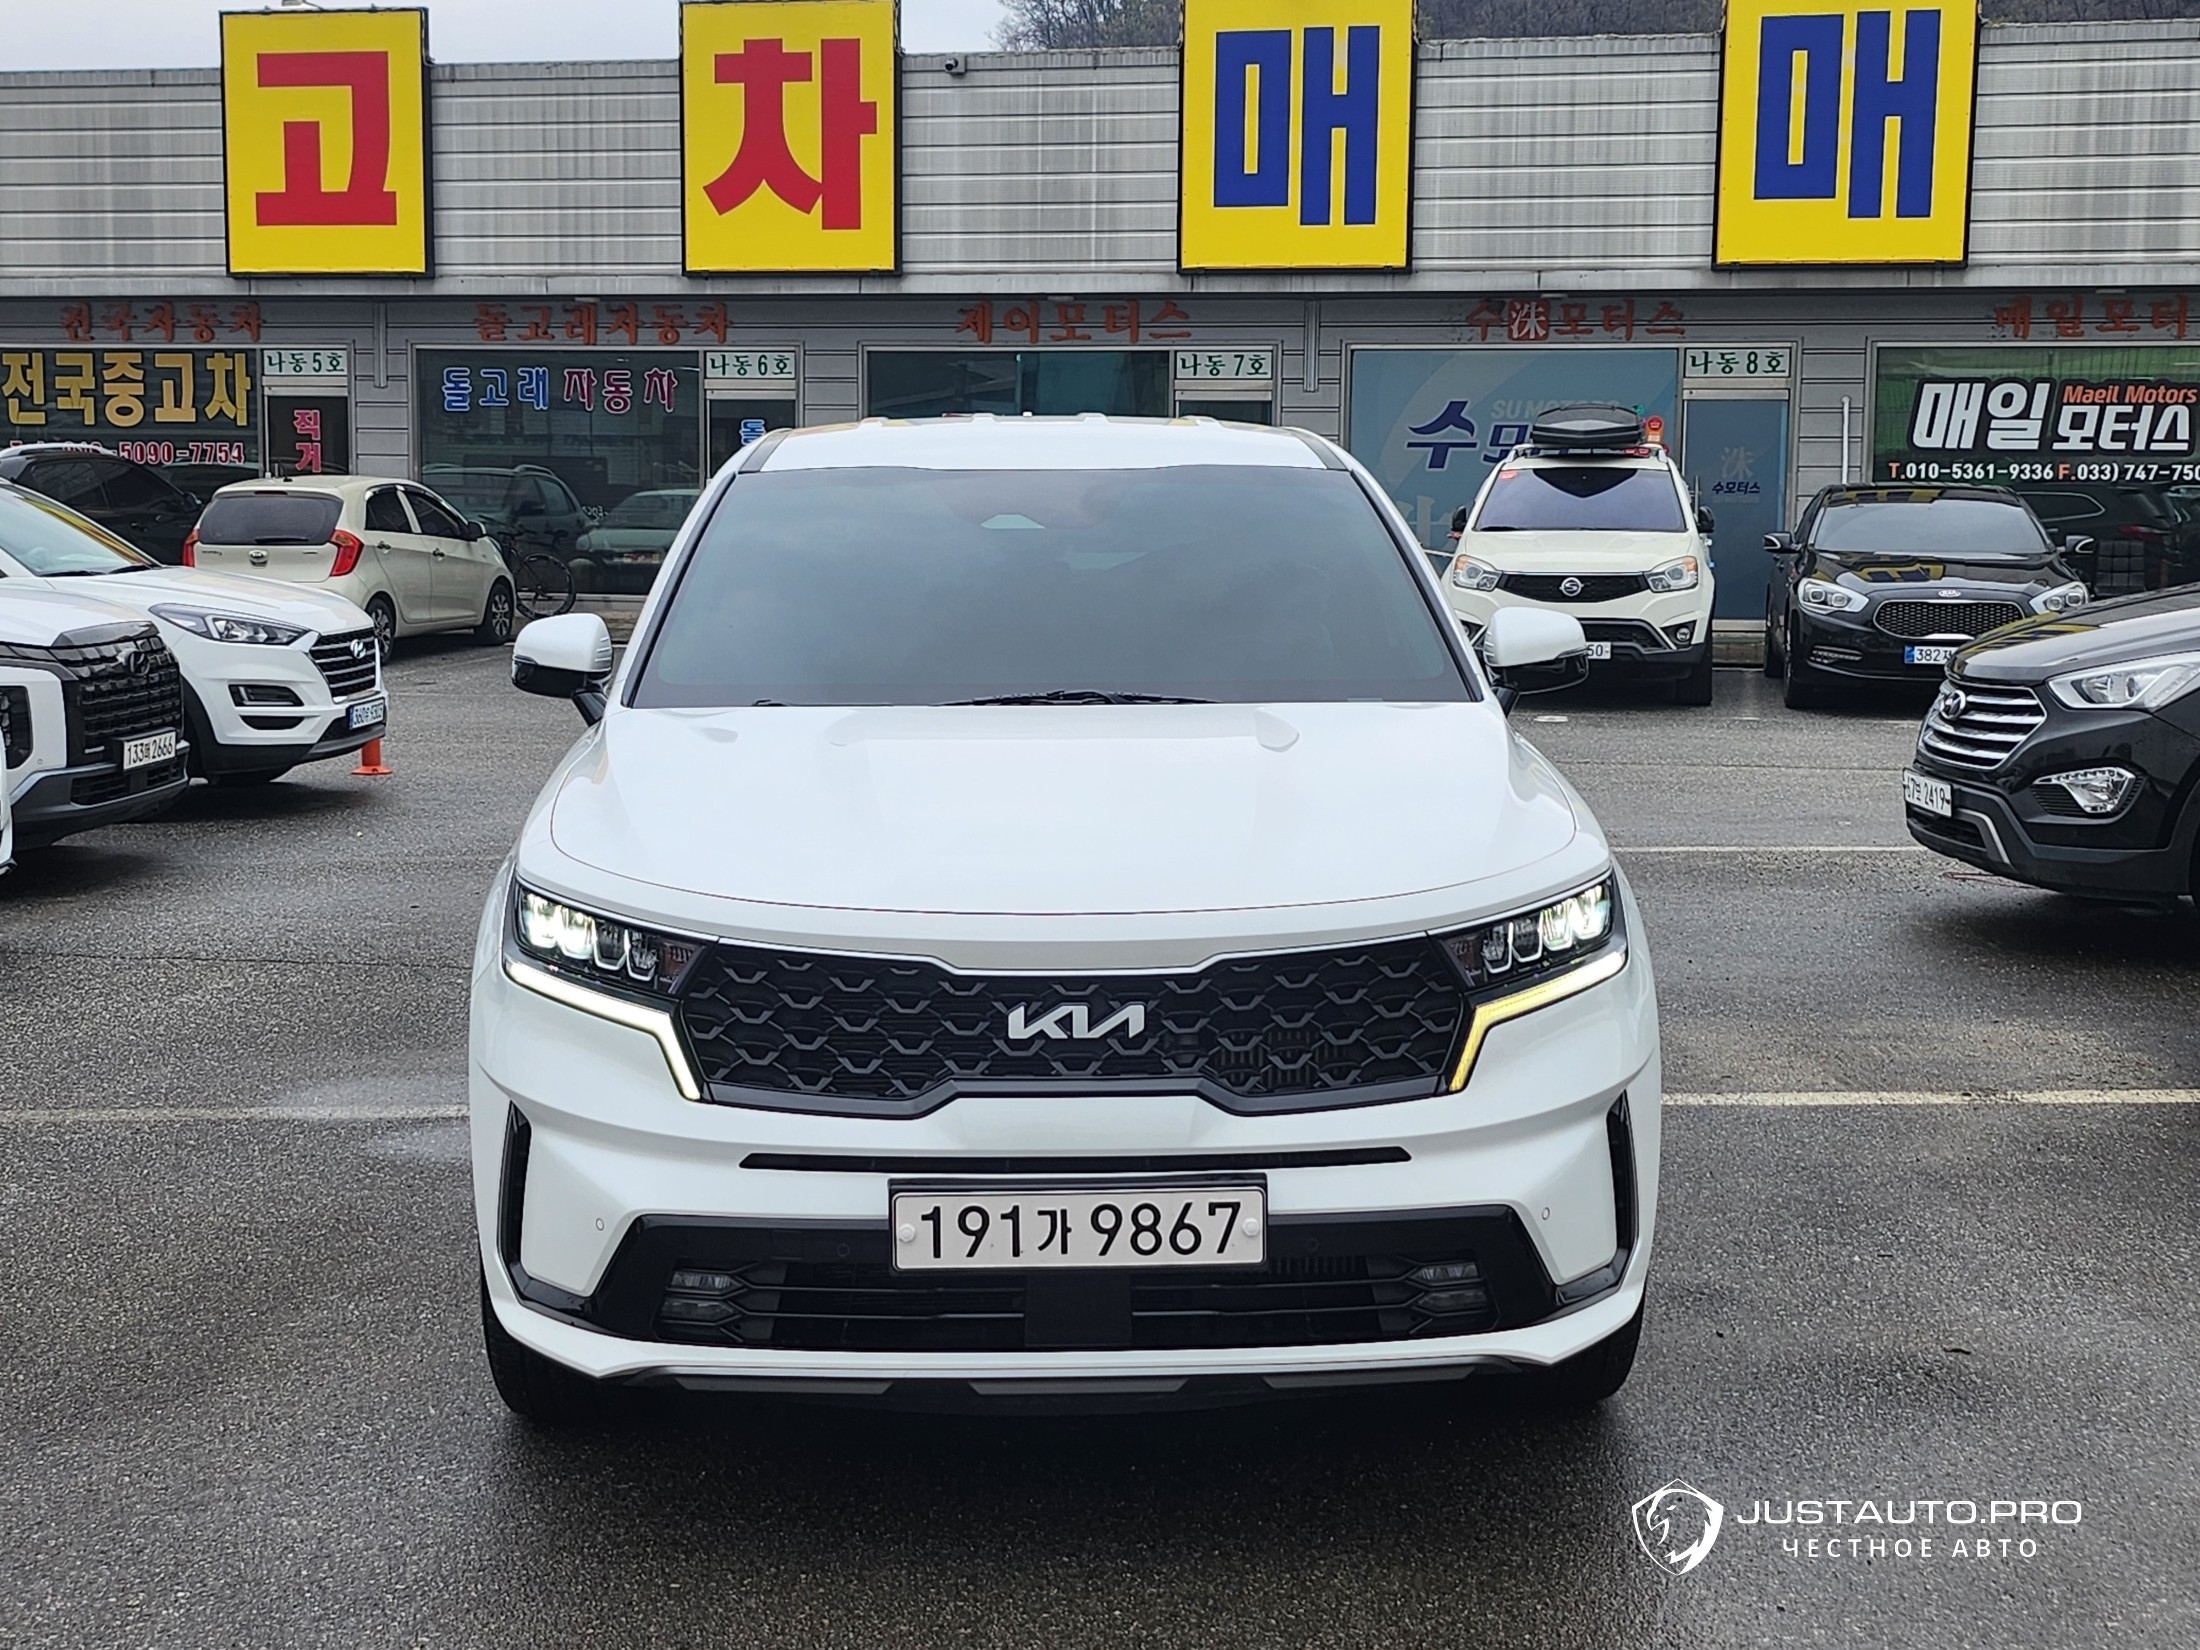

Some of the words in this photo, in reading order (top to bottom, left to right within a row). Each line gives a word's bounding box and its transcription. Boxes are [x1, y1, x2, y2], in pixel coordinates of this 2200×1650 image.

[256, 51, 397, 226] 고
[703, 38, 877, 230] 차
[1213, 26, 1380, 226] 매
[1753, 9, 1942, 218] 매
[474, 303, 732, 346] 돌고래자동차
[955, 301, 1192, 345] 제이모터스
[1, 353, 250, 427] 전국중고차
[442, 366, 549, 411] 돌고래
[564, 368, 678, 414] 자동차
[2062, 385, 2118, 404] Maeil
[2125, 385, 2198, 404] Motors
[1912, 382, 2050, 450] 매일
[2052, 405, 2190, 451] 모터스
[1711, 481, 1761, 495] 수모터스
[920, 1204, 1073, 1259] 191가
[1090, 1201, 1241, 1256] 9867
